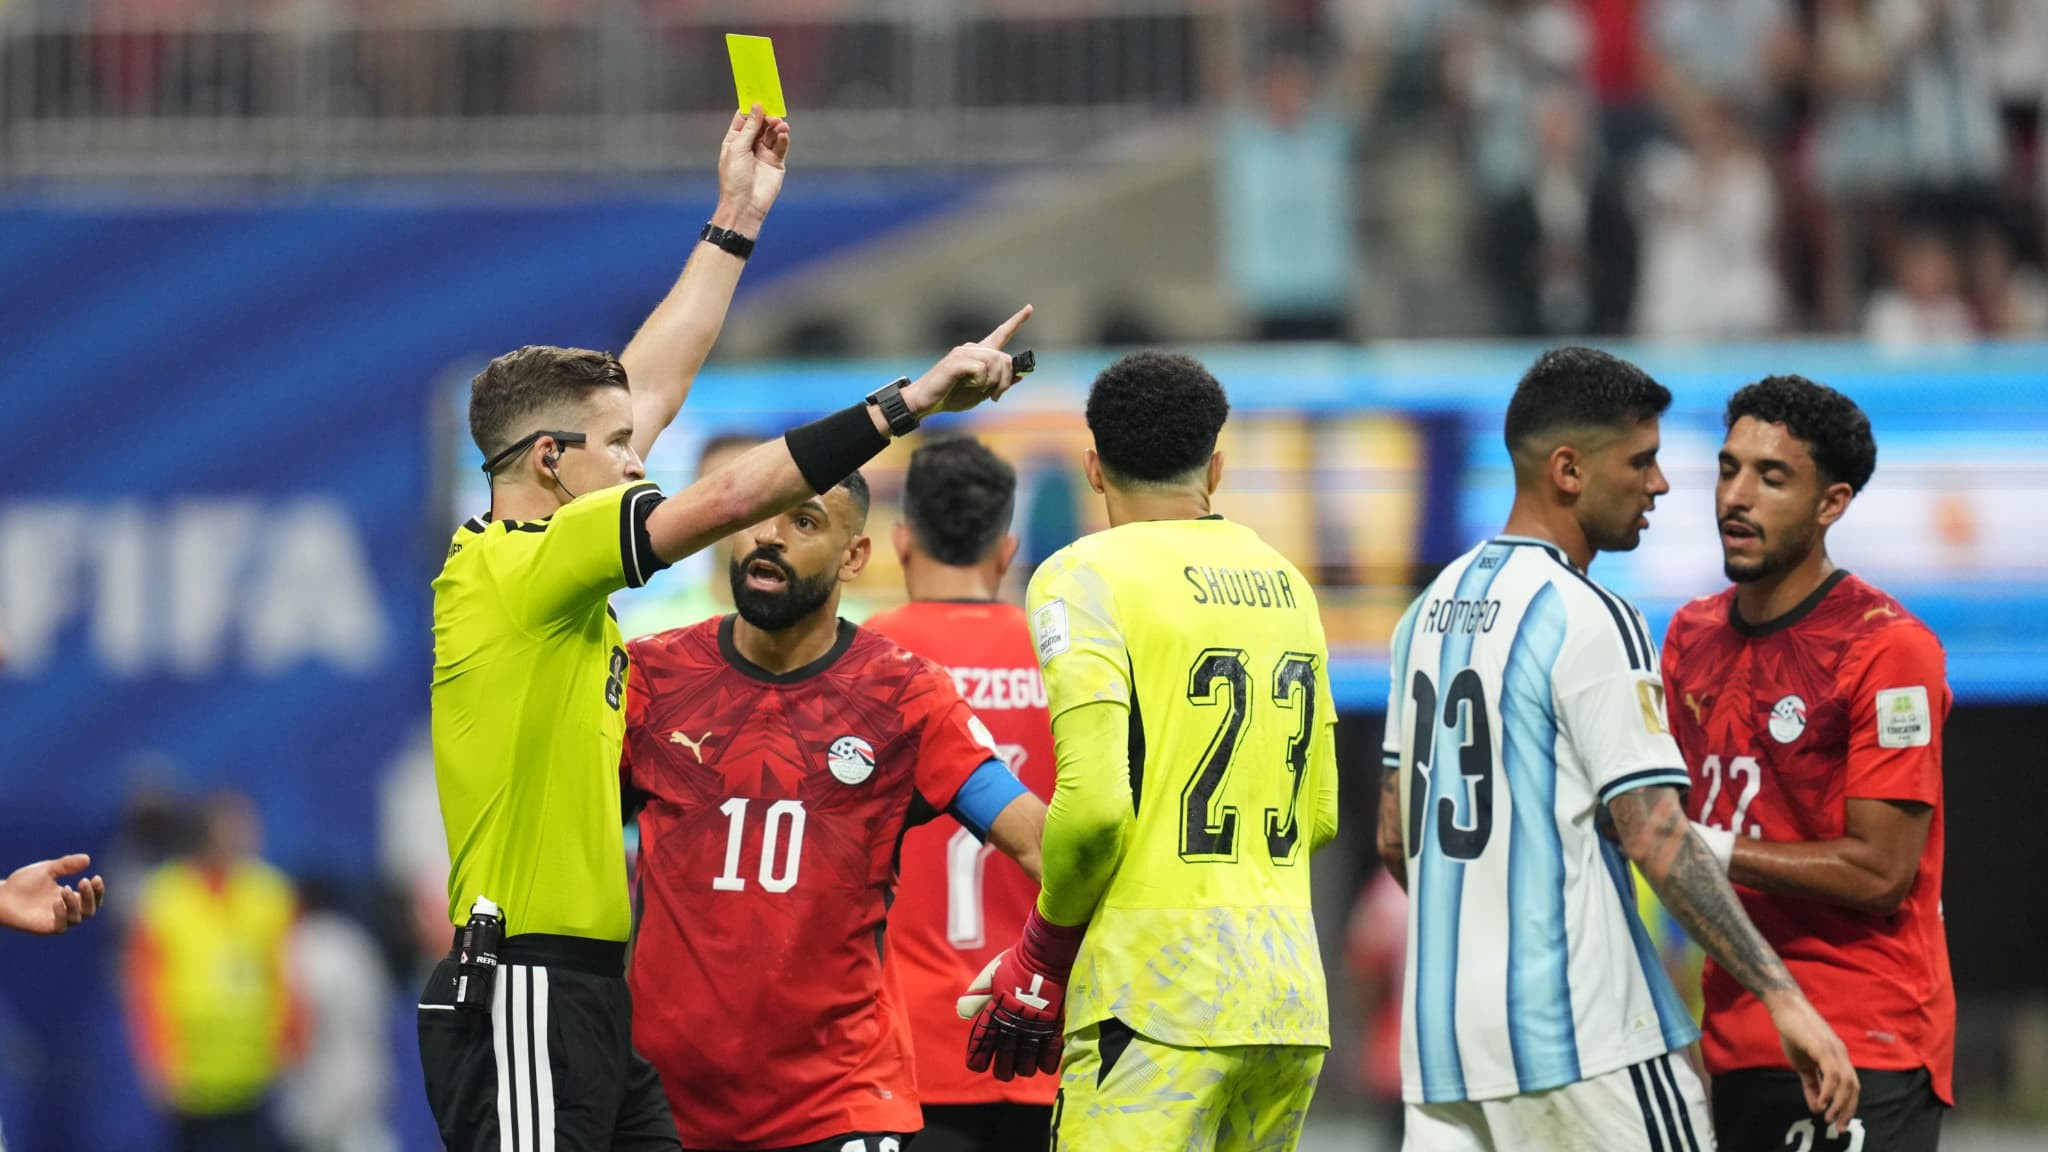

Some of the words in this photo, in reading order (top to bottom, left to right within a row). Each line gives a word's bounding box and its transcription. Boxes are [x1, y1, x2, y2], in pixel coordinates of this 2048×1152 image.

[2, 497, 391, 678] FIFA
[1183, 565, 1297, 609] SHOUBIR
[1423, 598, 1501, 634] ROMERO
[943, 667, 1048, 709] EZEGU
[1178, 647, 1320, 867] 23
[1408, 668, 1494, 861] 13
[1701, 754, 1761, 840] 22
[712, 797, 806, 893] 10
